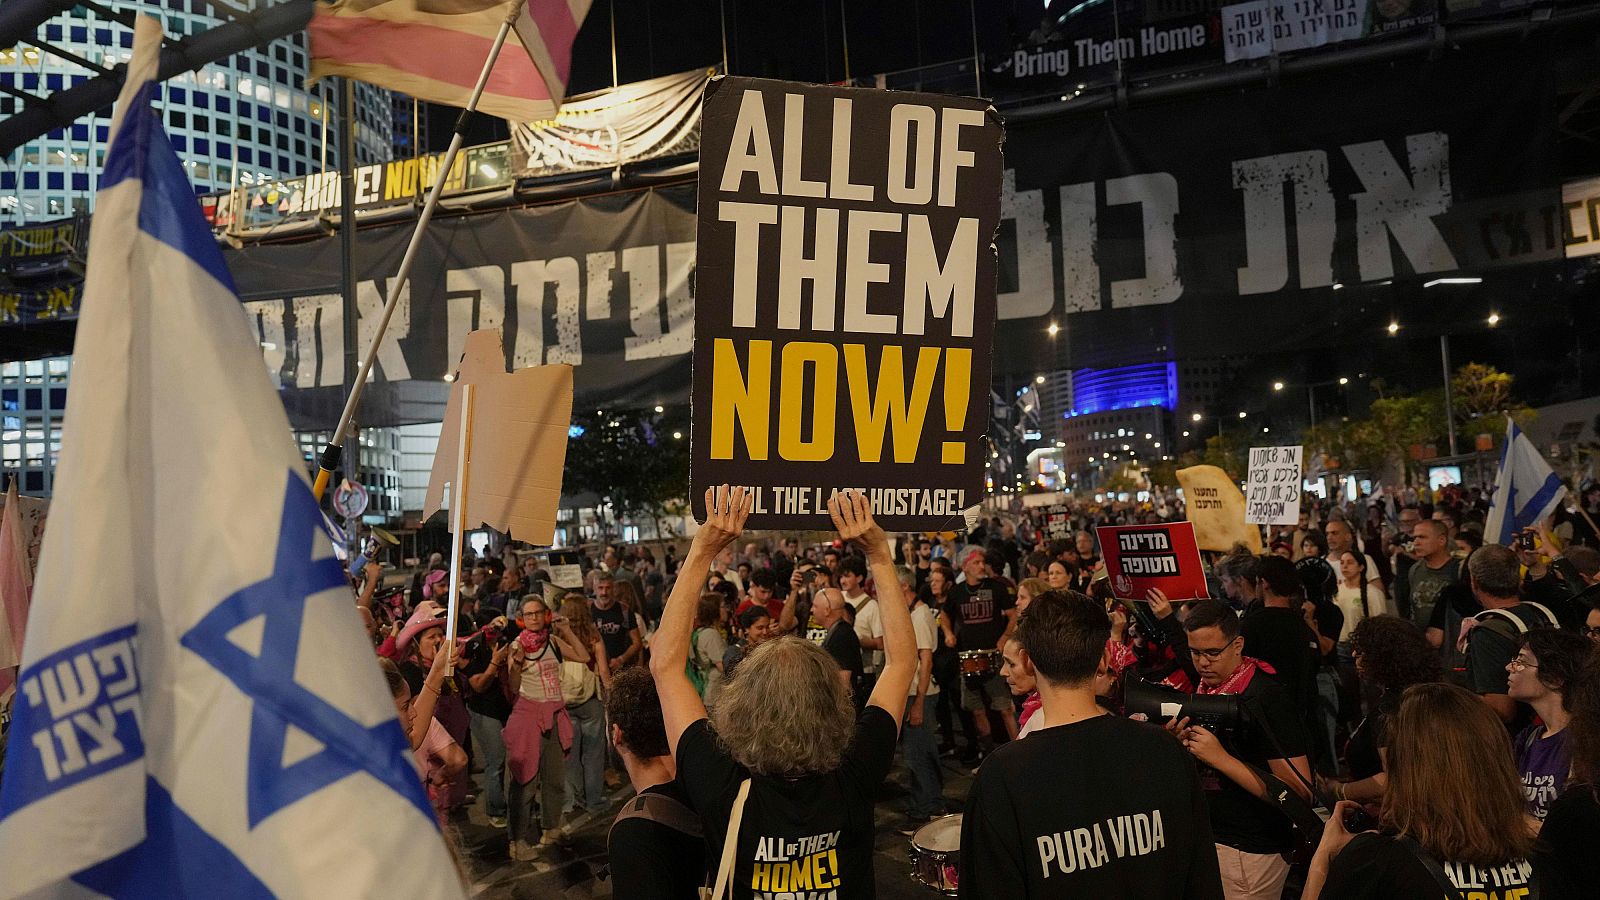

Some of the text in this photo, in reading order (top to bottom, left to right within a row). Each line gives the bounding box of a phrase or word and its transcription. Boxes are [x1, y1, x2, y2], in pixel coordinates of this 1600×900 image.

[1013, 24, 1206, 78] Bring Them Home
[1229, 11, 1358, 47] תחזירו גם אותי
[719, 90, 874, 202] ALL
[887, 104, 985, 207] OF
[997, 168, 1184, 320] כול
[1232, 132, 1458, 296] את
[446, 241, 697, 373] עימה
[718, 201, 980, 338] THEM
[710, 338, 973, 465] NOW!
[772, 486, 811, 514] THE
[870, 489, 965, 516] HOSTAGE!
[1119, 532, 1169, 551] מדינה
[1121, 555, 1177, 574] חטופה
[22, 638, 140, 720] פשי
[31, 694, 144, 783] רצנו
[751, 848, 841, 892] HOME!
[754, 830, 840, 862] ALL OF THEM
[1036, 809, 1166, 879] PURA VIDA
